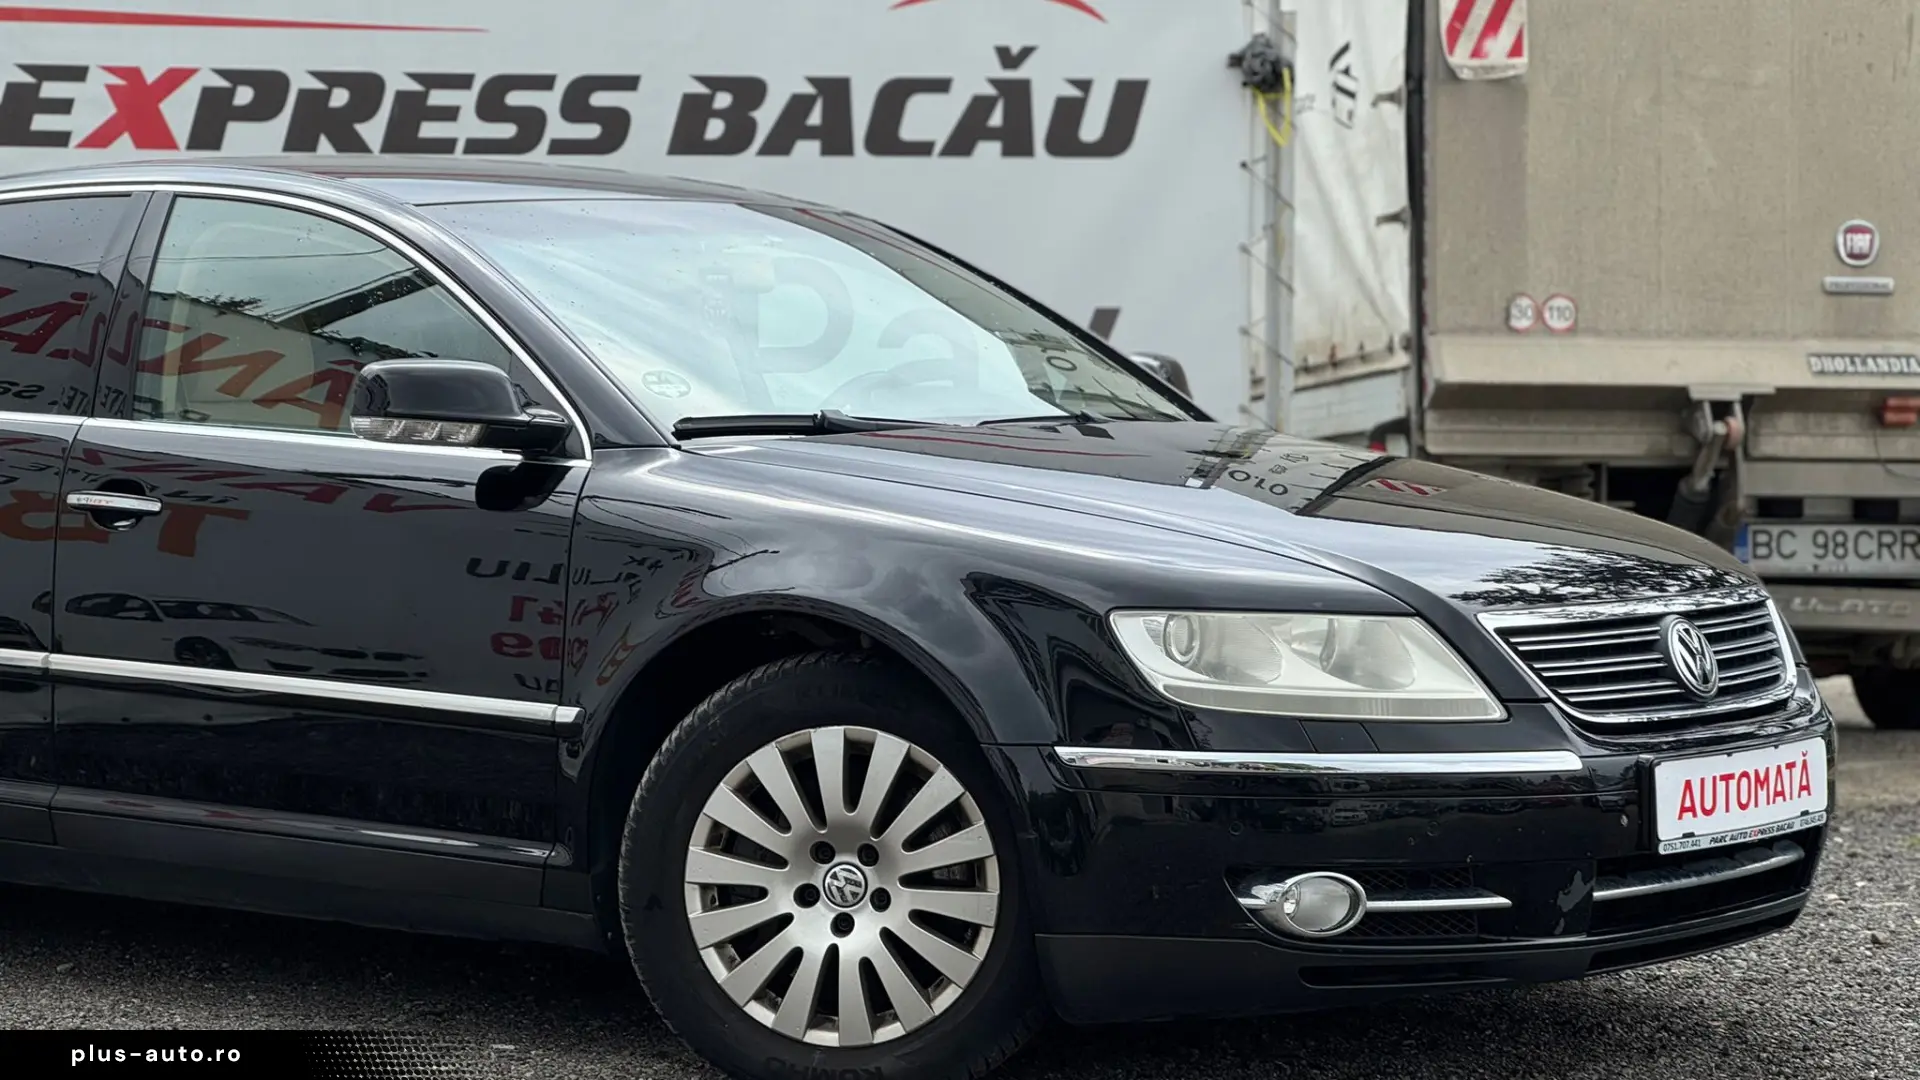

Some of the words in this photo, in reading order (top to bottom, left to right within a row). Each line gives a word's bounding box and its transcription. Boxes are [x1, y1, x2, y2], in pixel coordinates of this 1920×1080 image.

[0, 64, 641, 155] EXPRESS
[667, 46, 1150, 158] BACĂU
[1846, 232, 1871, 254] FIAT
[1810, 355, 1920, 374] DHOLLANDIA
[1752, 530, 1797, 559] BC
[1677, 750, 1812, 821] AUTOMATĂ
[1709, 834, 1727, 845] PARC
[1729, 830, 1748, 842] AUTO
[1749, 826, 1774, 839] EXPRESS
